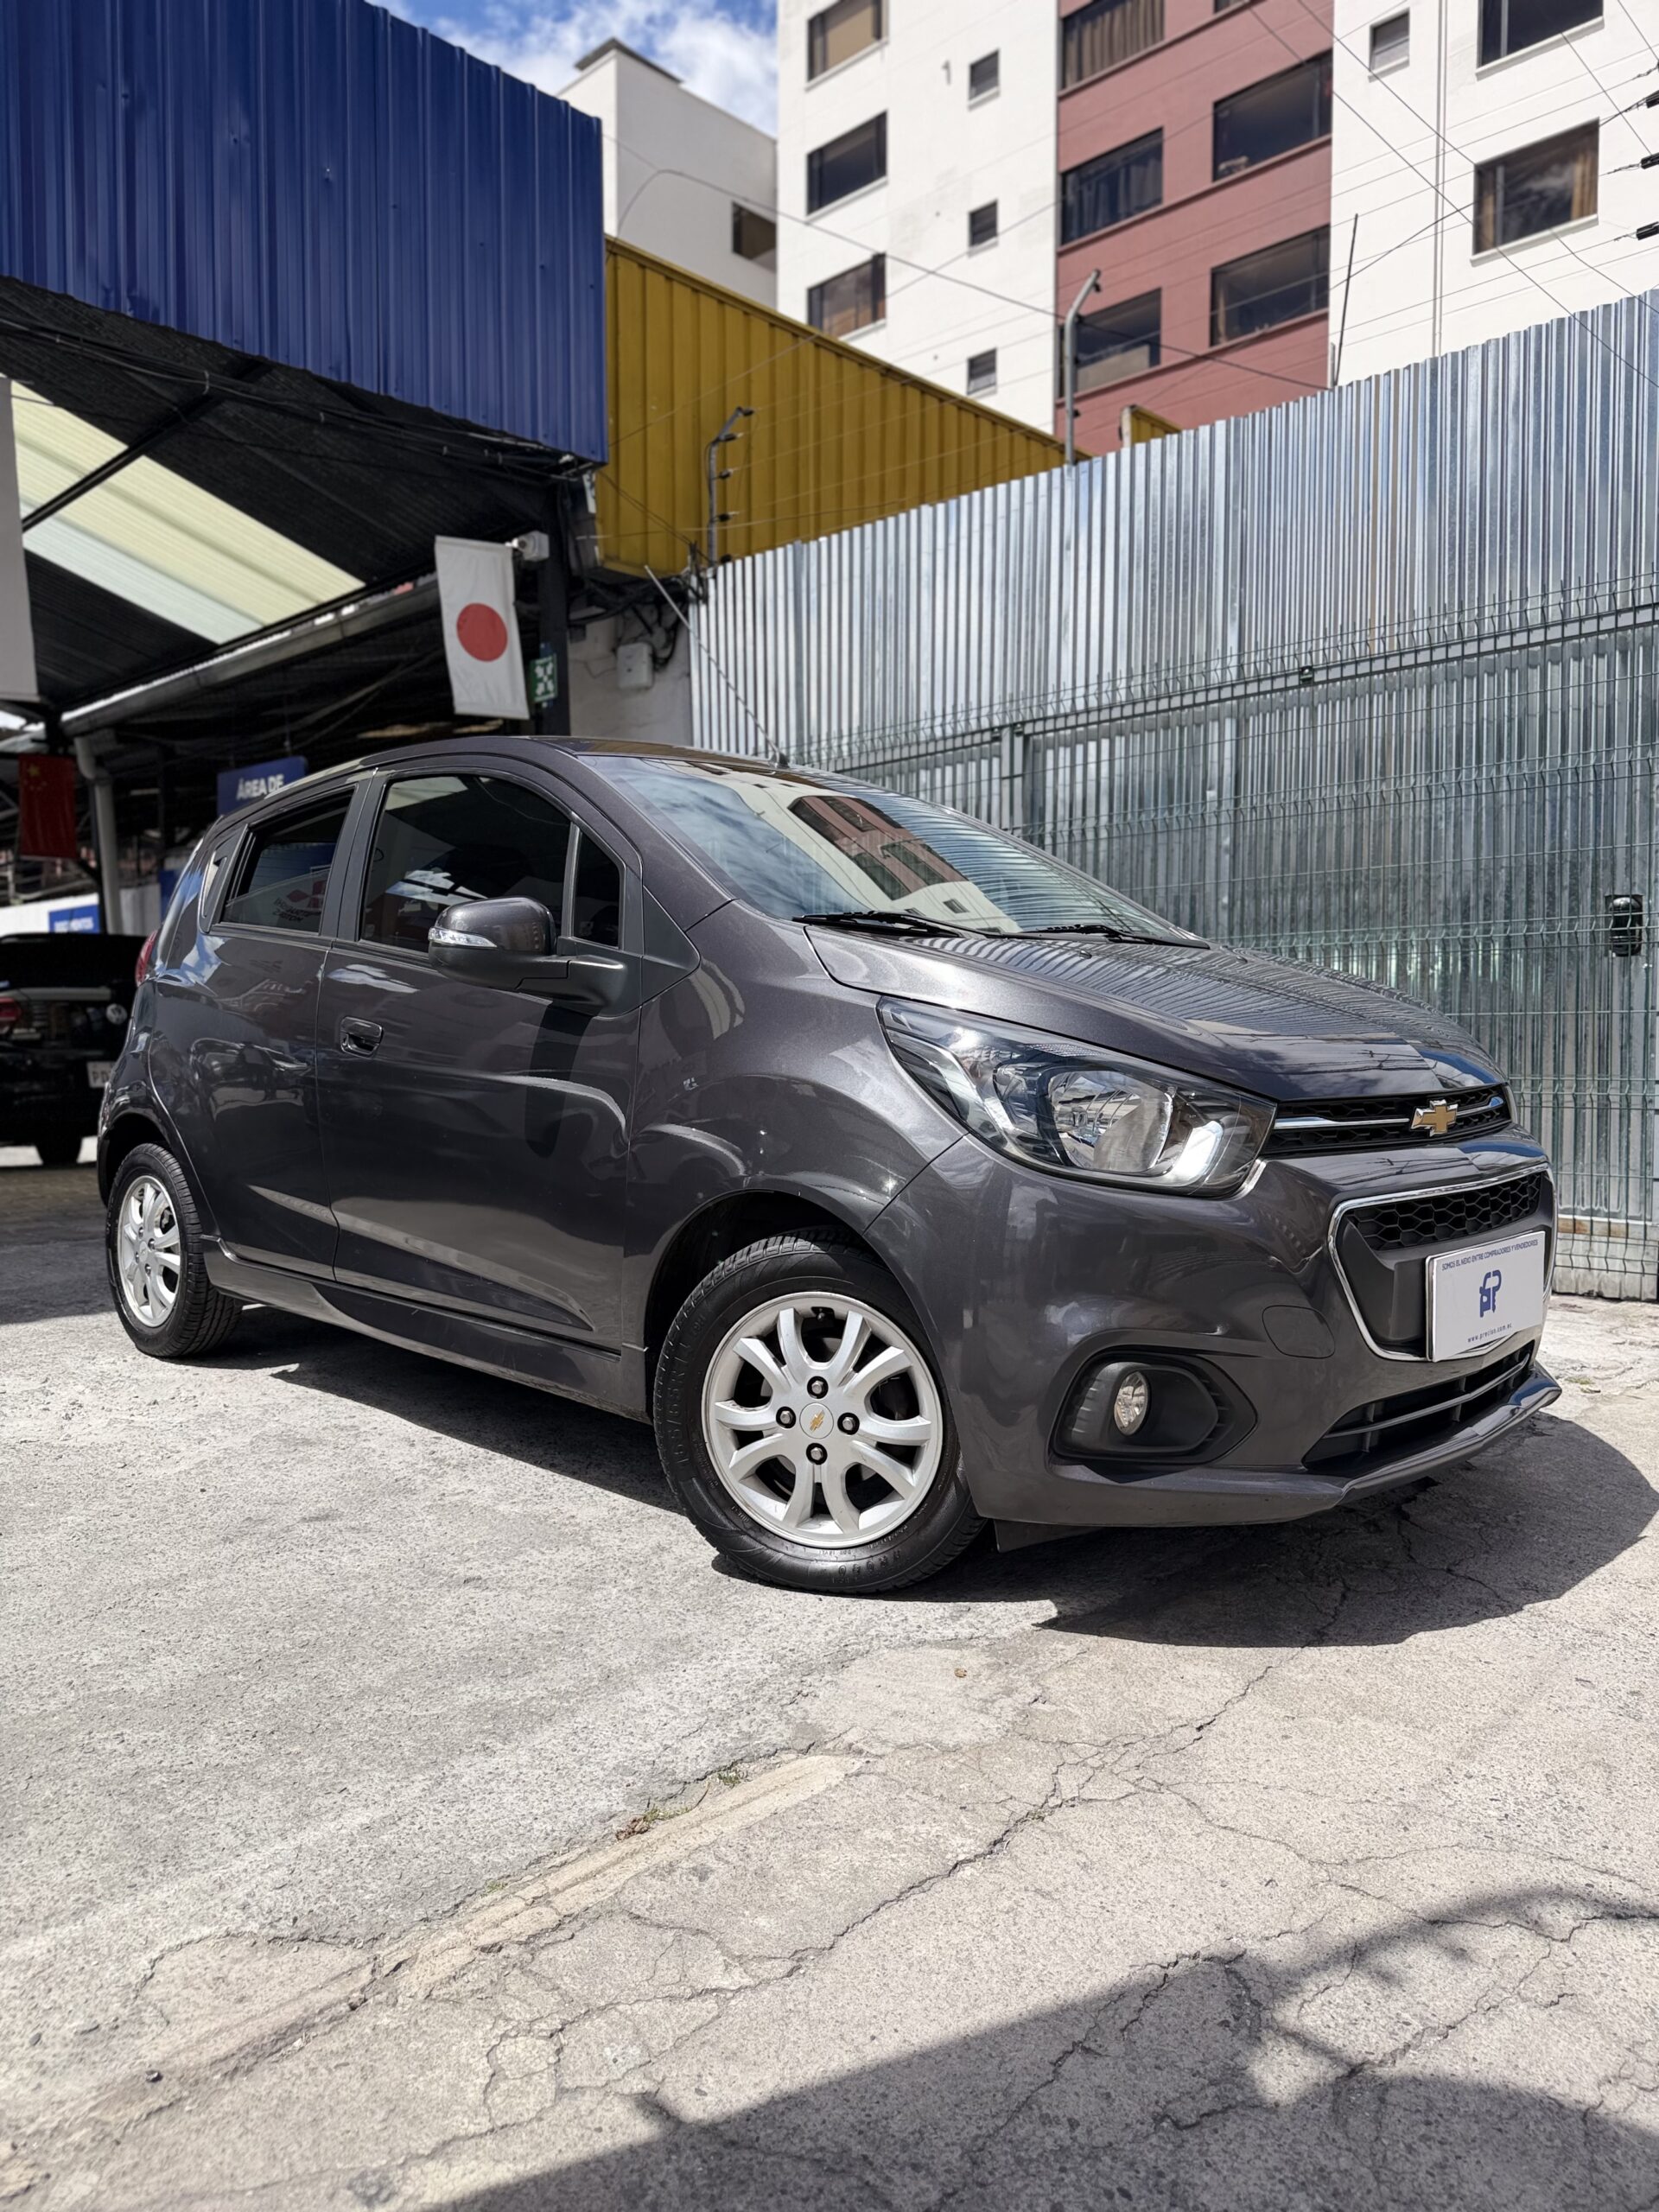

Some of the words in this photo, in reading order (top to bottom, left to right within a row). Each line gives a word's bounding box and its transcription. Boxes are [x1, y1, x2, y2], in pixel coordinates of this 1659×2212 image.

[1441, 1260, 1455, 1271] SOMOS
[1460, 1255, 1471, 1266] NEXO
[1471, 1253, 1484, 1262] ENTRE
[1484, 1246, 1510, 1260] COMPRADORES
[1514, 1239, 1538, 1251] VENDEDORES
